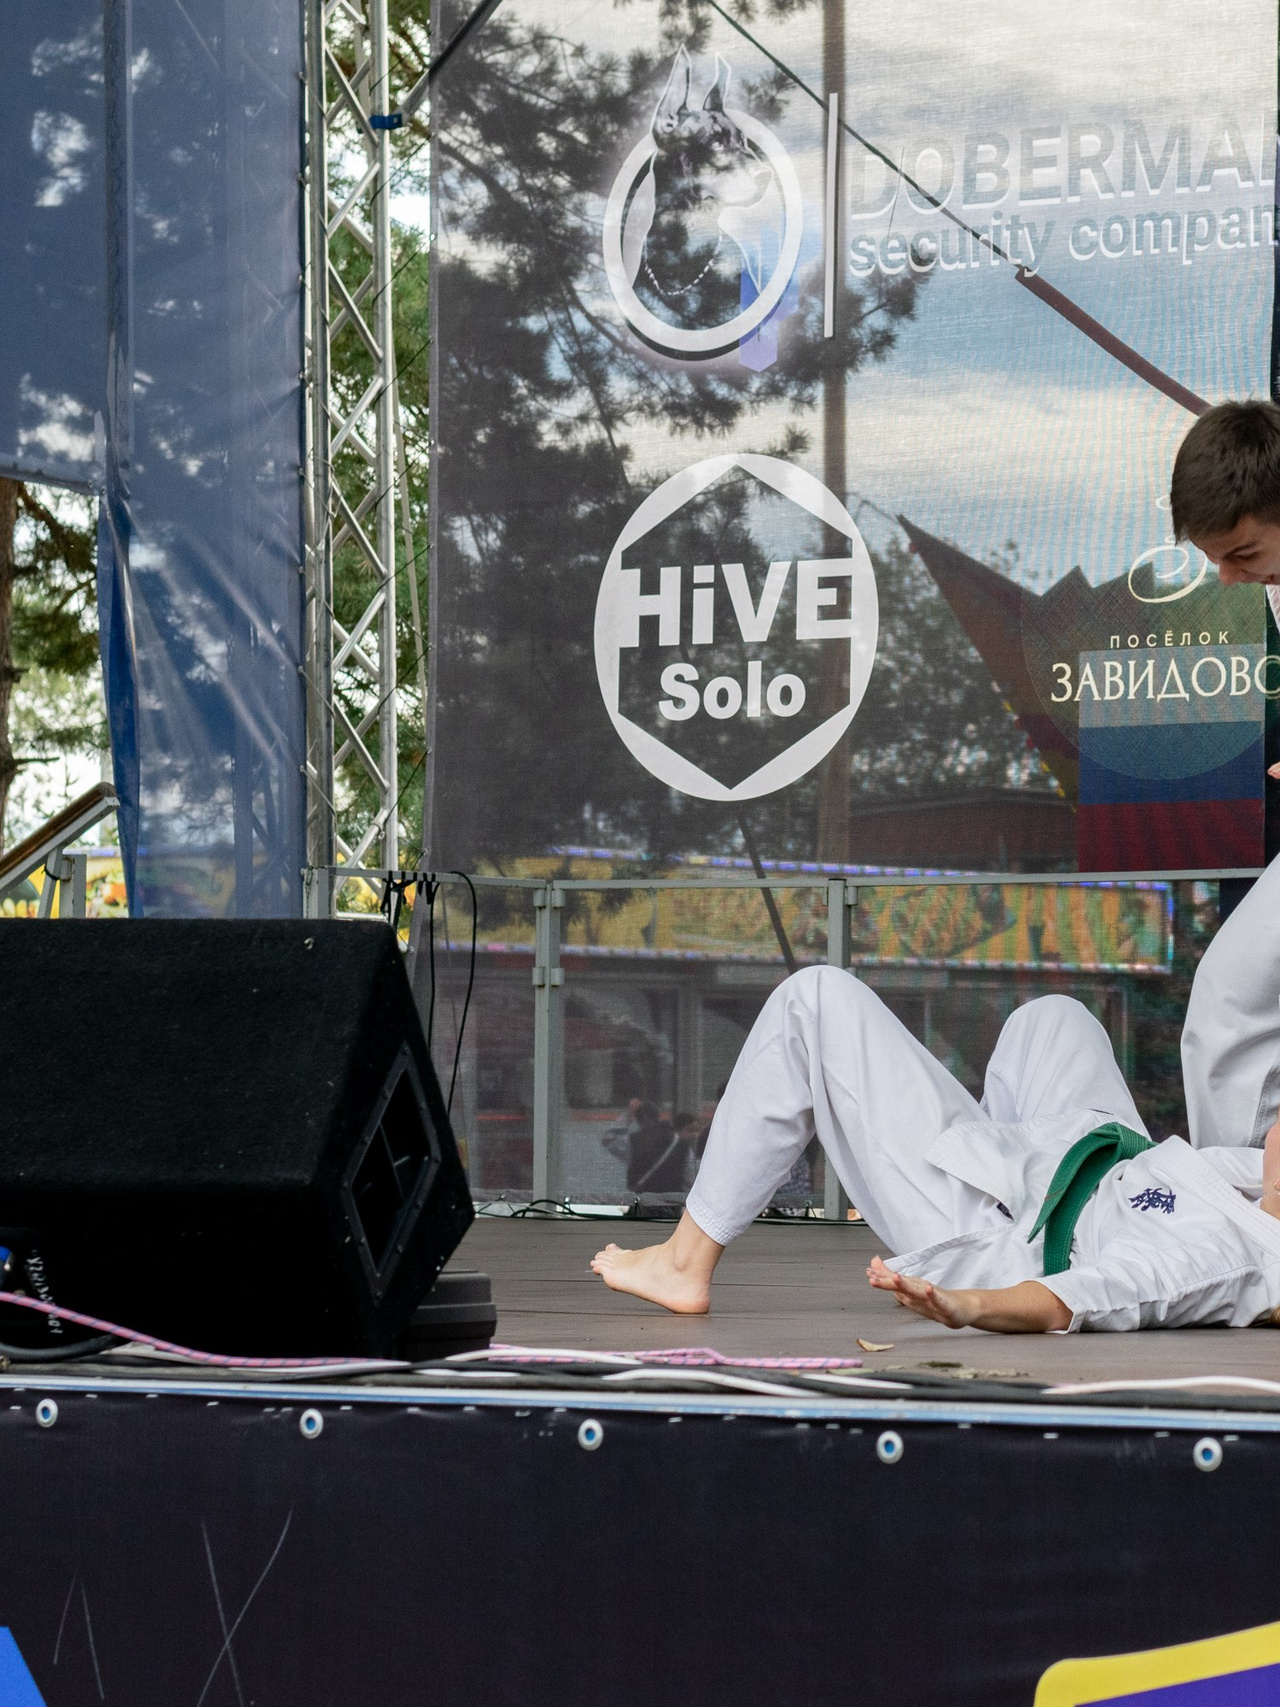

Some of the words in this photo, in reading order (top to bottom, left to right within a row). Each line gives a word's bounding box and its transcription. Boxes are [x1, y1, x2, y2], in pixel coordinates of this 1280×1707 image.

[849, 210, 1056, 278] security
[619, 557, 853, 649] HiVE
[1110, 630, 1229, 650] ПОСЁЛОК
[658, 660, 806, 722] Solo
